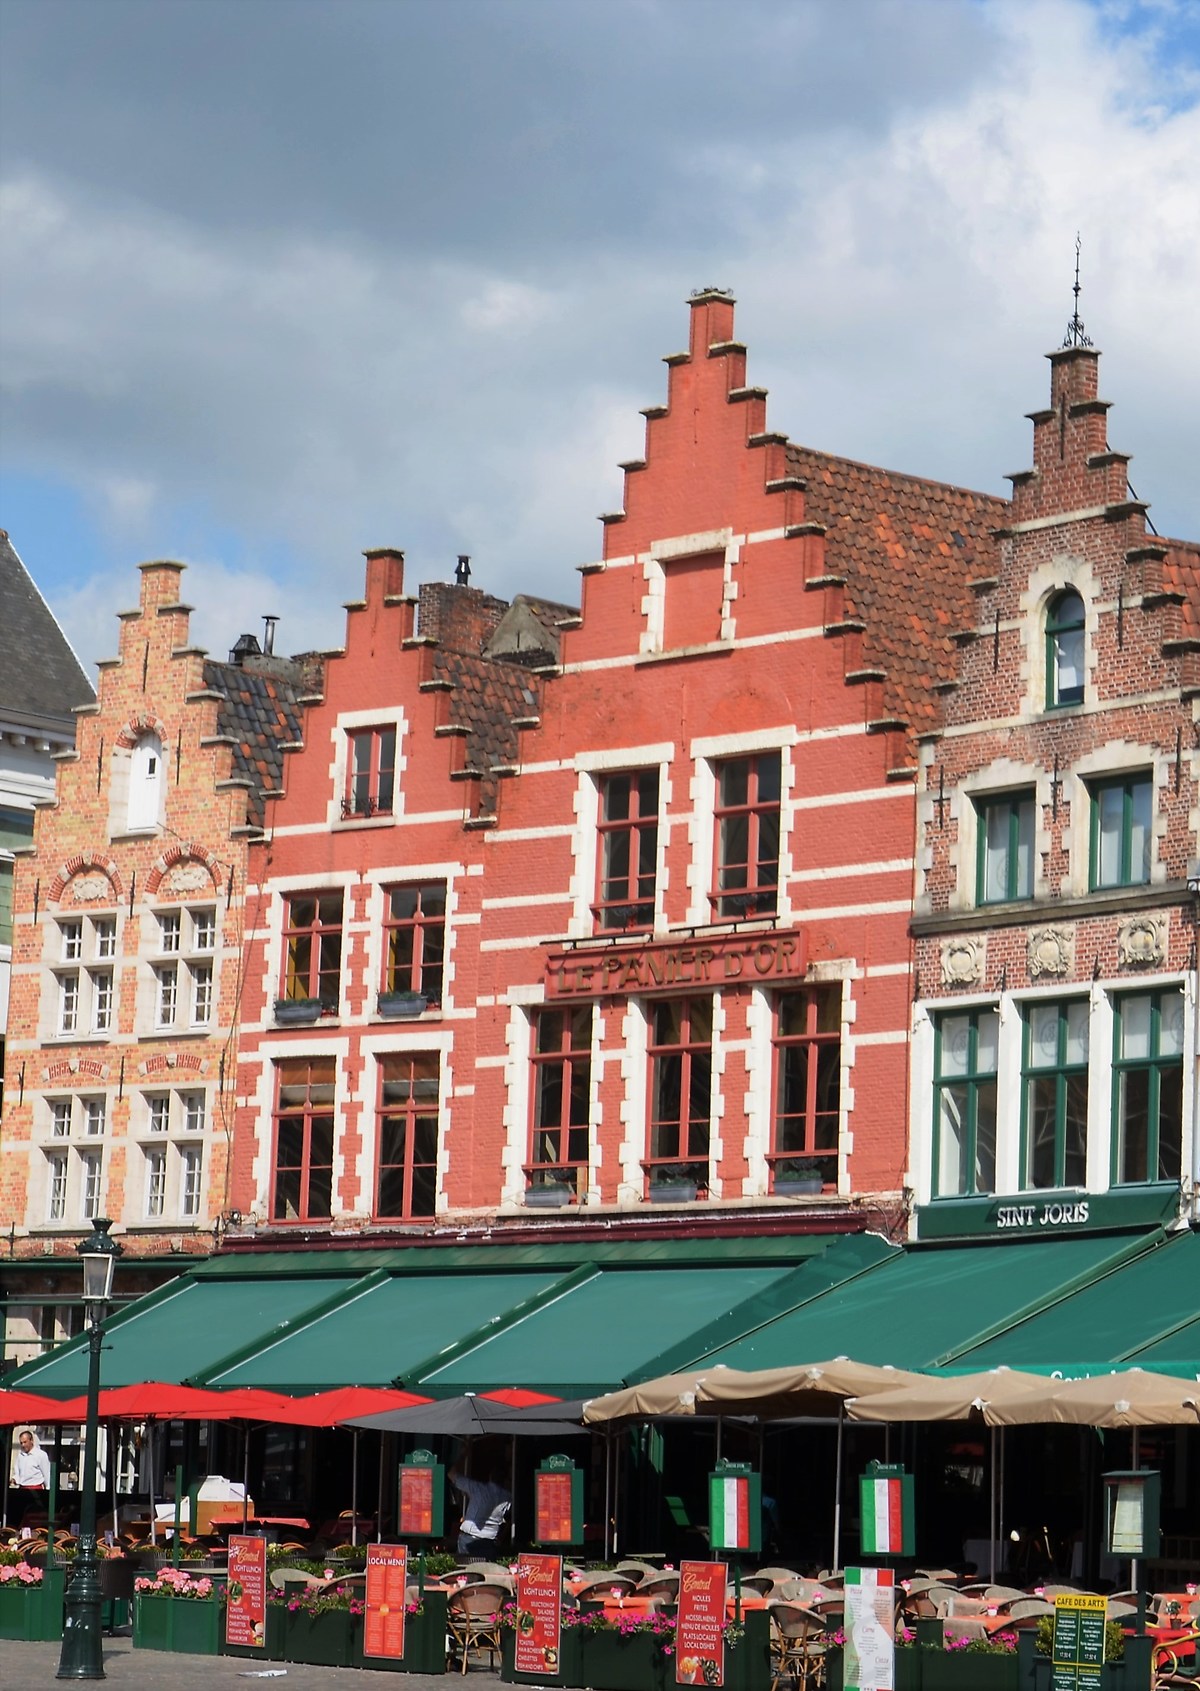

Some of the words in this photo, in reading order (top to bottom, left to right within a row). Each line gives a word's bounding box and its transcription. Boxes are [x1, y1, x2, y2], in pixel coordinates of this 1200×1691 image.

[558, 965, 593, 993] LE
[602, 948, 714, 989] PANIER
[724, 939, 796, 977] D'OR
[997, 1205, 1036, 1228] SINT
[1040, 1202, 1089, 1225] JORIS
[368, 1557, 386, 1566] LOCAL
[387, 1558, 405, 1567] MENU
[528, 1565, 554, 1584] Central
[683, 1573, 712, 1592] Central
[524, 1588, 539, 1596] LIGHT
[538, 1589, 556, 1597] LUNCH
[692, 1595, 711, 1603] MOULES
[1057, 1598, 1072, 1606] CAFE
[1074, 1599, 1086, 1607] DES
[694, 1604, 708, 1612] FRITES
[702, 1624, 720, 1632] MOULES
[683, 1632, 695, 1640] PLATS
[696, 1633, 717, 1641] LOCALES
[700, 1642, 715, 1650] DISHES
